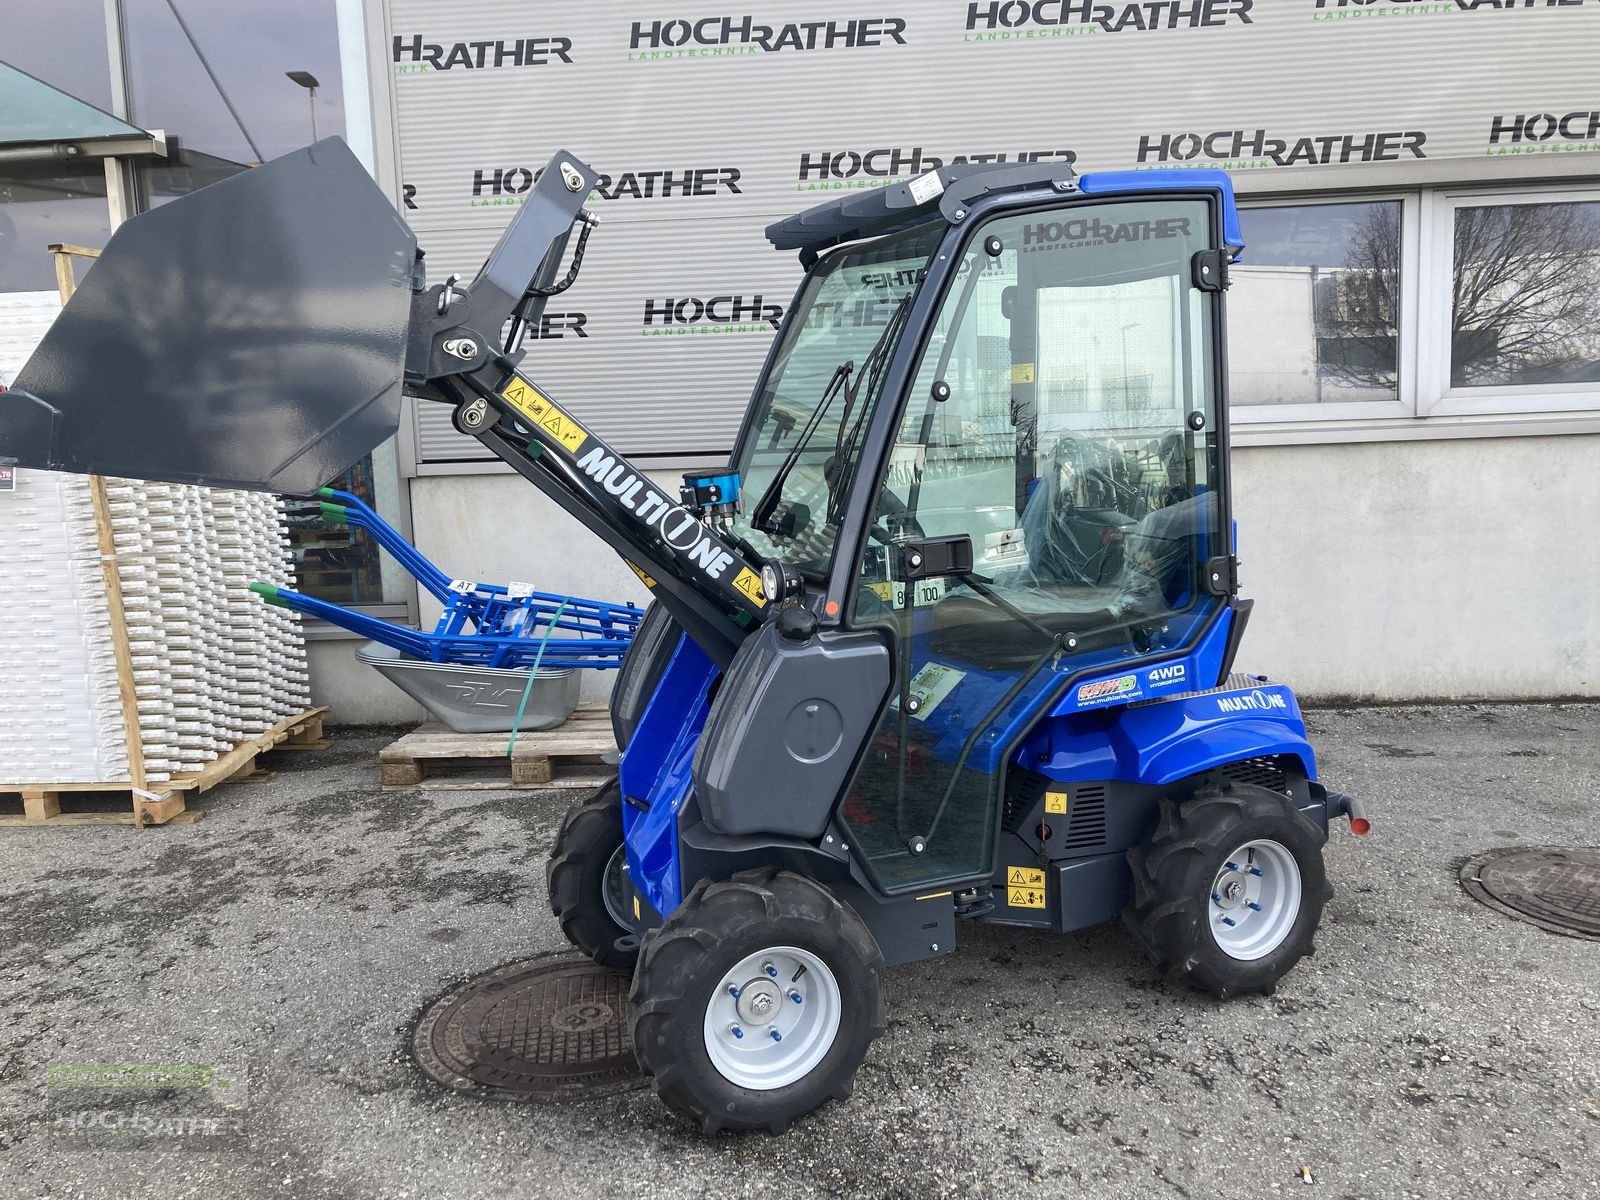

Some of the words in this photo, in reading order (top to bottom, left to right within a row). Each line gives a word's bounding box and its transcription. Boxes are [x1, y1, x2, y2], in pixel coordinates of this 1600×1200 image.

[965, 0, 1254, 32] HOCHRATHER
[1313, 5, 1452, 21] LANDTECHNIK
[629, 16, 907, 52] HOCHRATHER
[964, 26, 1097, 42] LANDTECHNIK
[628, 45, 757, 61] LANDTECHNIK
[1137, 129, 1427, 167] HOCHRATHER
[472, 167, 743, 200] HORATHER
[1023, 217, 1193, 246] HOCHRATHER
[642, 324, 767, 336] LANDTECHNIK
[457, 581, 473, 591] AT
[921, 587, 938, 602] 100
[1148, 664, 1185, 681] 4WD
[1149, 676, 1186, 689] HYDROSTATIC
[1077, 690, 1143, 707] www.multione.com
